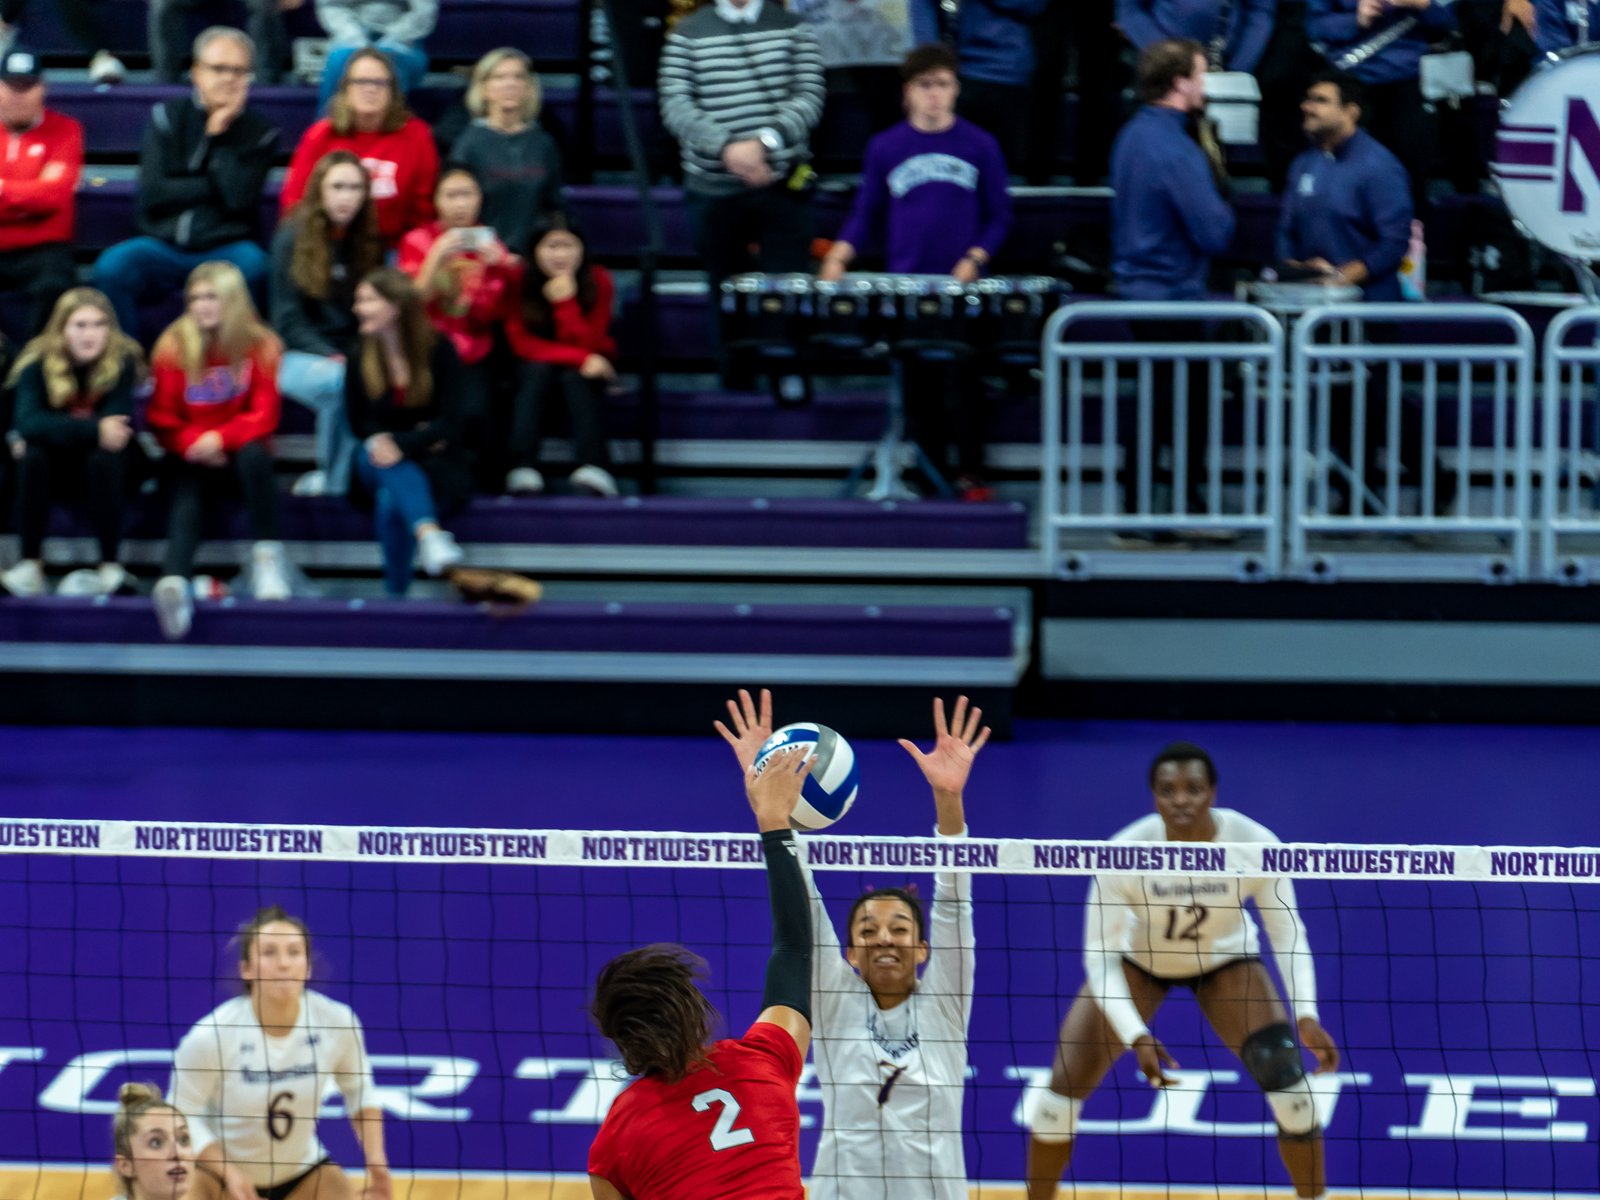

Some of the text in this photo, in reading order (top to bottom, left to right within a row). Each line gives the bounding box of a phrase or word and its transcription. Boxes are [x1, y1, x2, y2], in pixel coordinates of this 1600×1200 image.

[135, 826, 323, 853] NORTHWESTERN
[358, 831, 547, 859] NORTHWESTERN
[807, 841, 999, 867] NORTHWESTERN
[1034, 845, 1226, 871] NORTHWESTERN
[1262, 848, 1455, 875] NORTHWESTERN
[1163, 904, 1208, 941] 12
[267, 1091, 294, 1141] 6
[690, 1087, 756, 1153] 2
